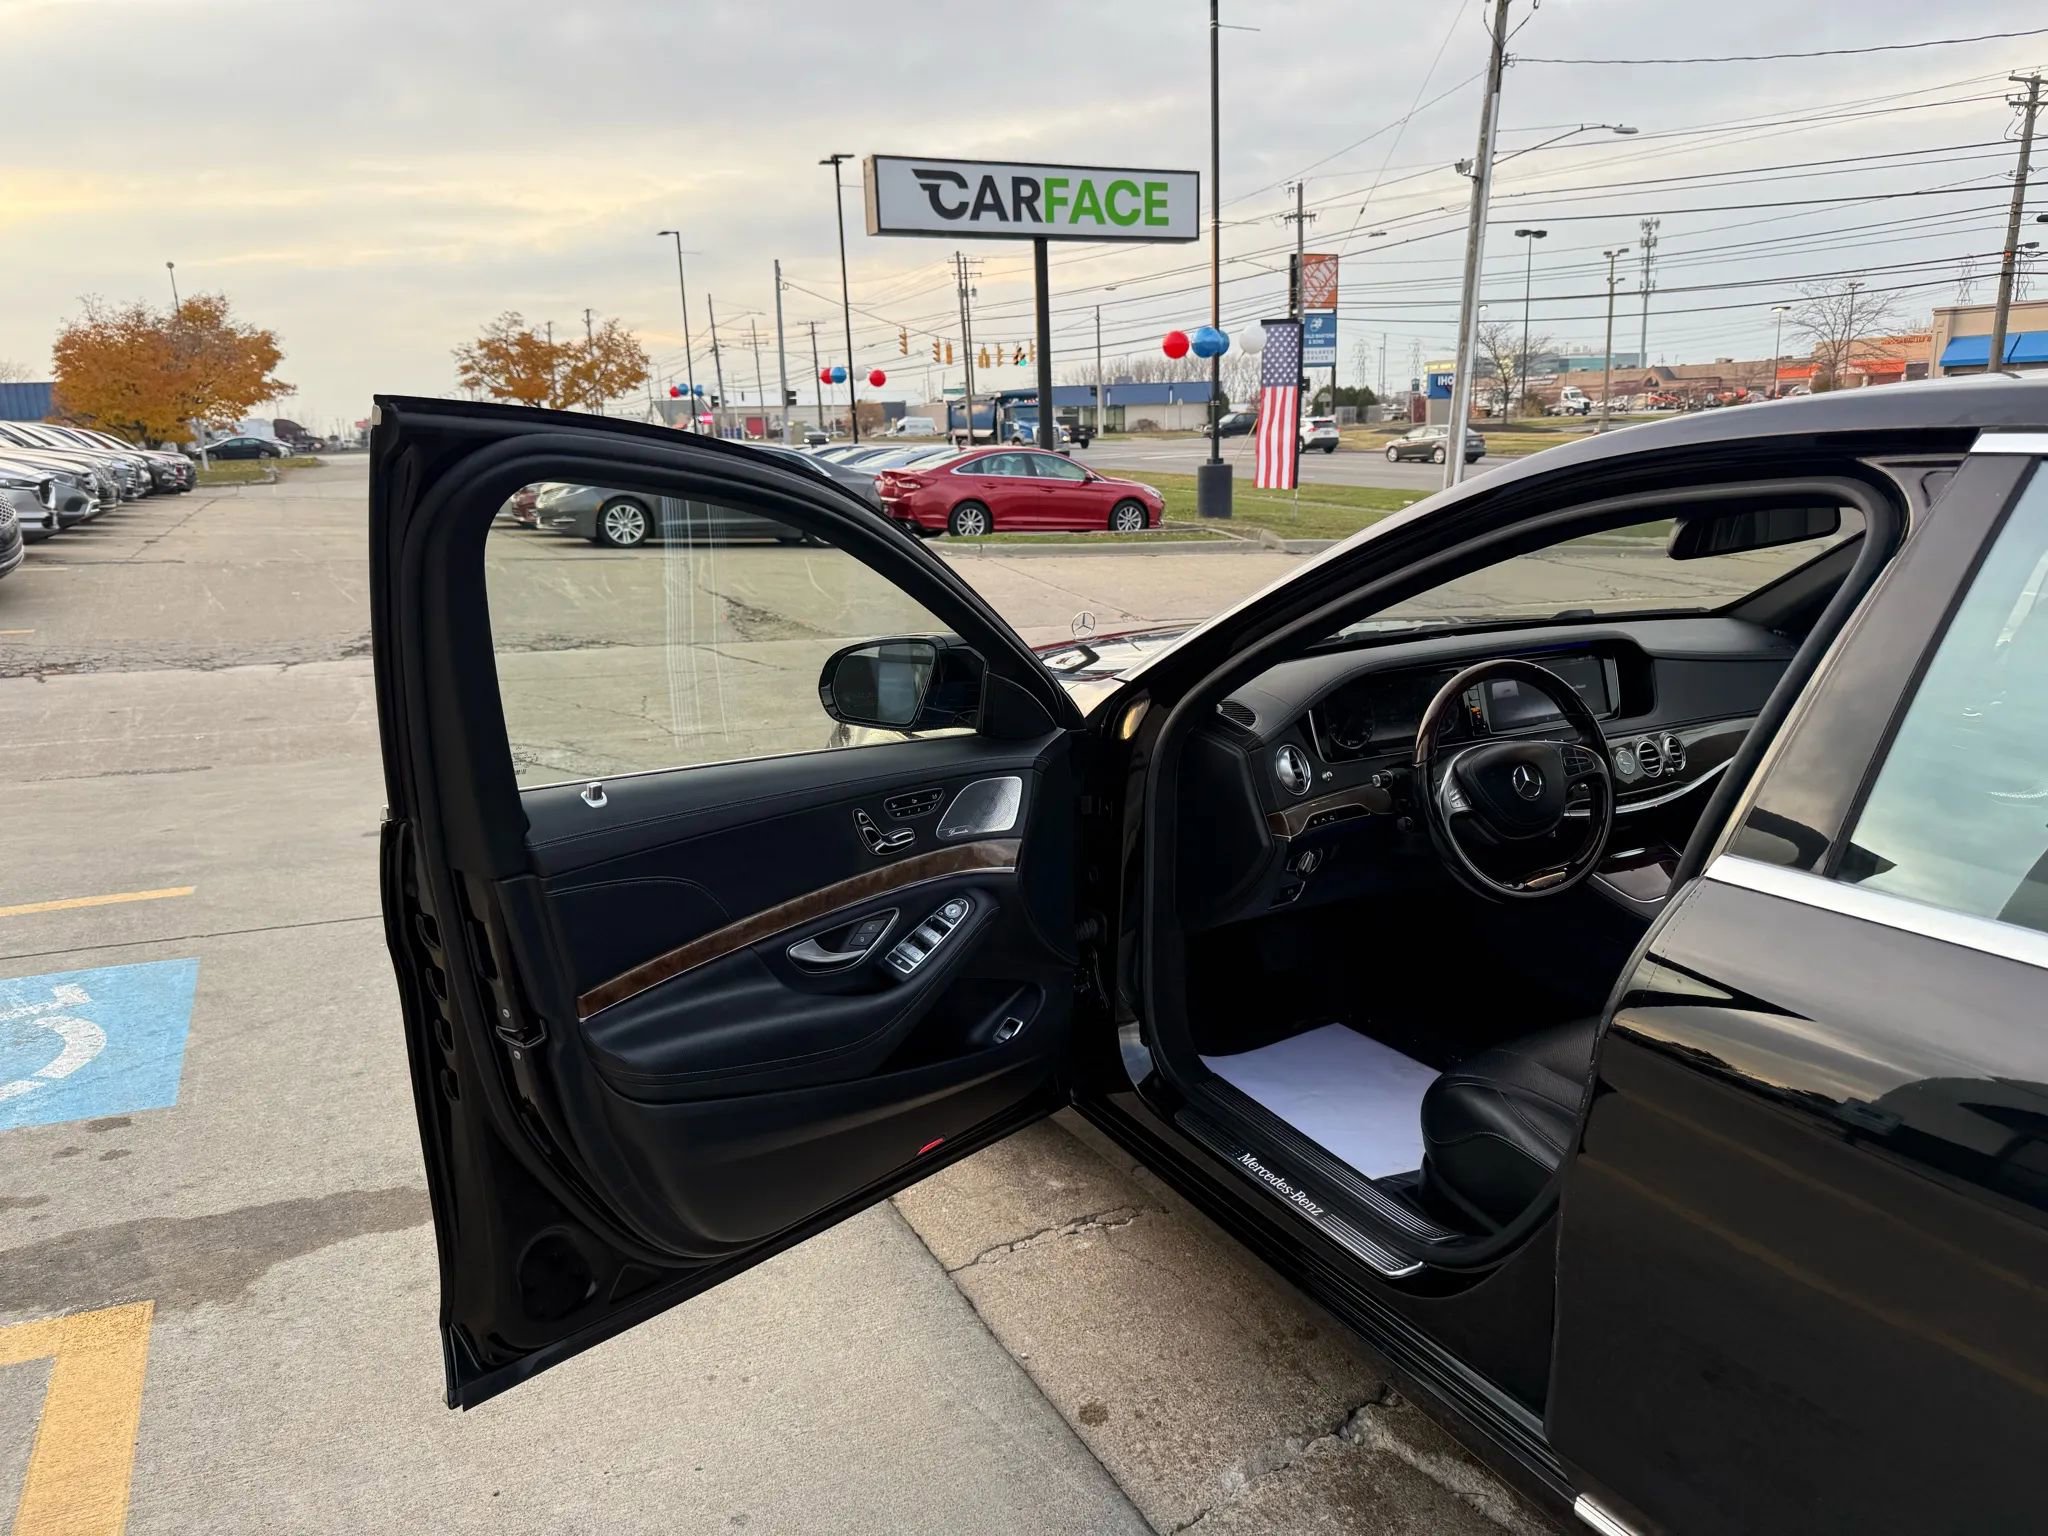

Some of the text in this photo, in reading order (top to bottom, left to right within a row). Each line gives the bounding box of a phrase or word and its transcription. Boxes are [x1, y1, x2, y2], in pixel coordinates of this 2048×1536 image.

[911, 168, 1170, 226] CARFACE
[1437, 375, 1456, 386] IHO
[1237, 1152, 1324, 1216] Mercedes-Benz
